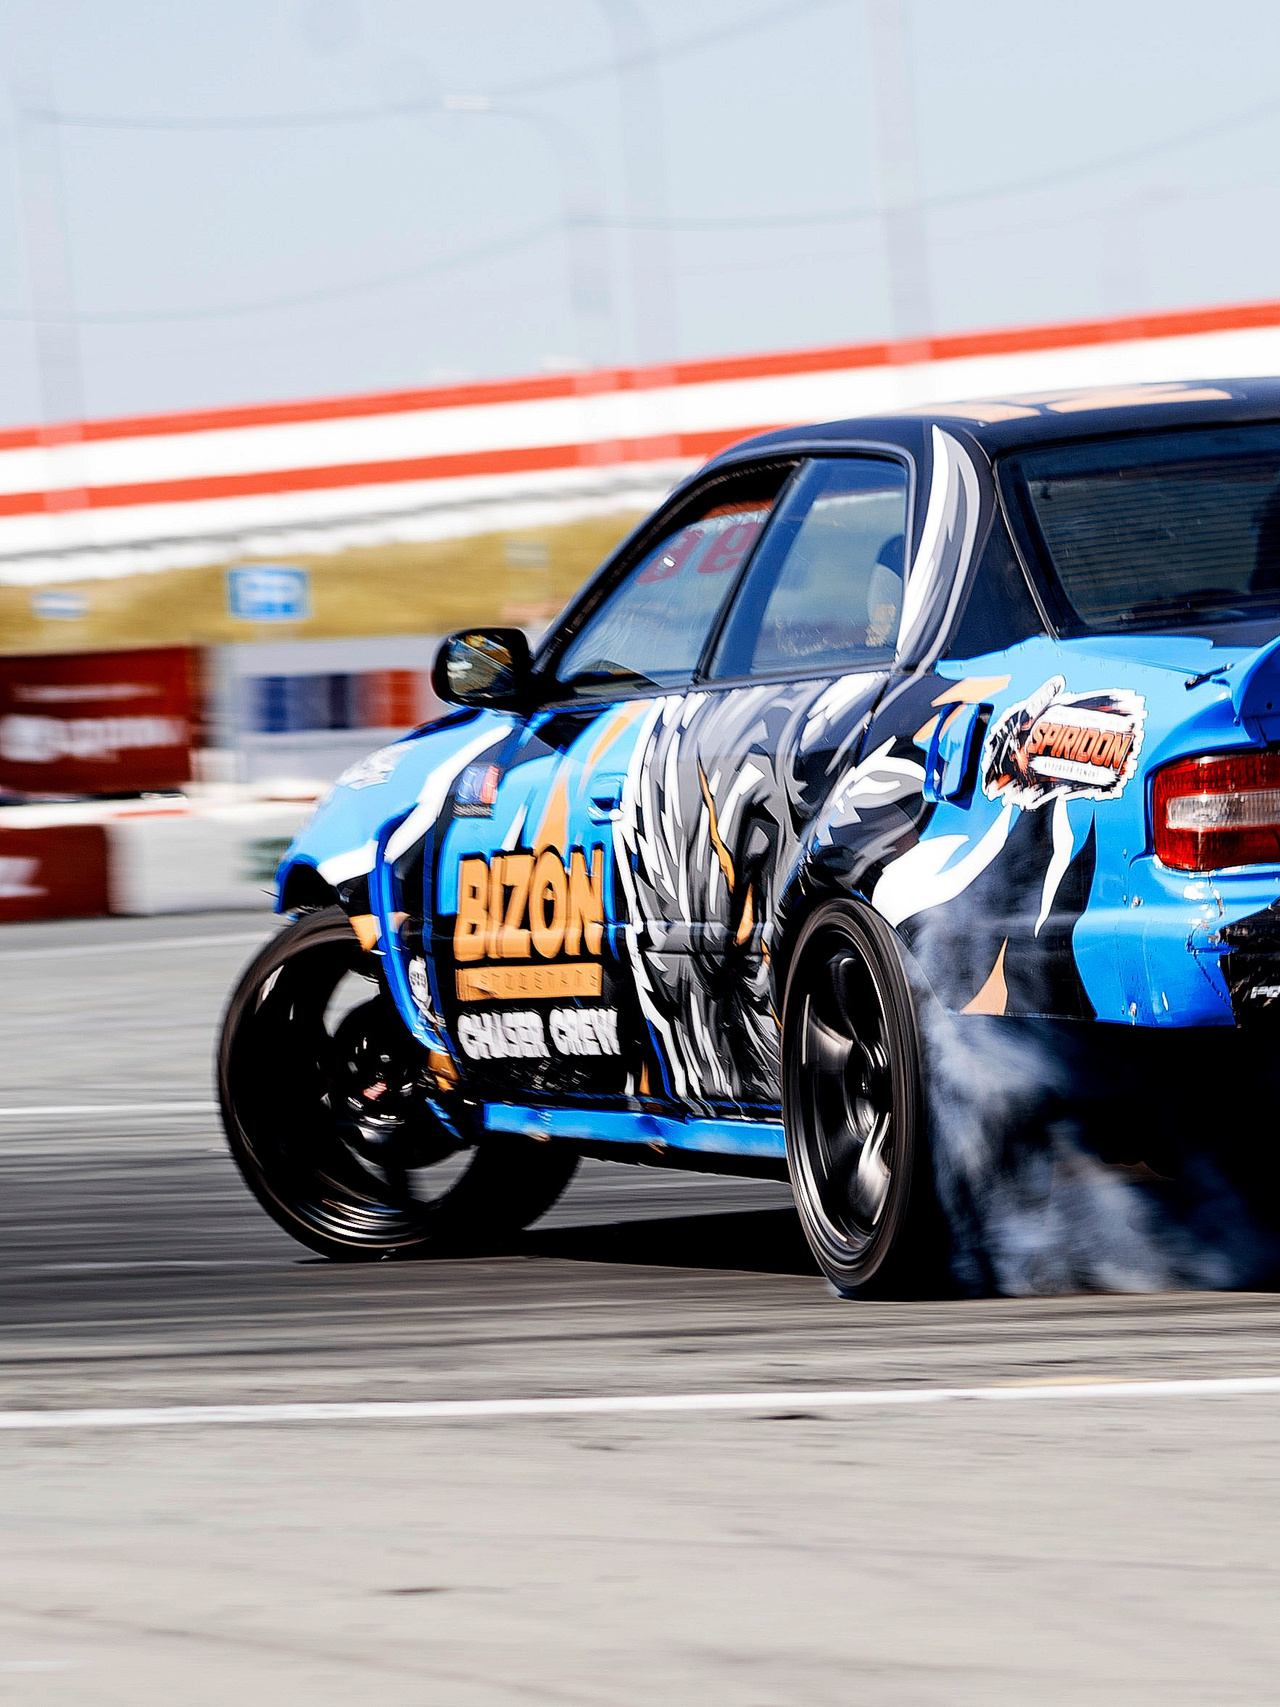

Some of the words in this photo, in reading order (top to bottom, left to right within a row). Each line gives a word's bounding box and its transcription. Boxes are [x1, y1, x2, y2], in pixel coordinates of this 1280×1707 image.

[1029, 722, 1132, 769] SPIRIDON
[453, 849, 603, 961] BIZON
[457, 1011, 550, 1060] CHASER
[549, 1008, 621, 1056] CREW
